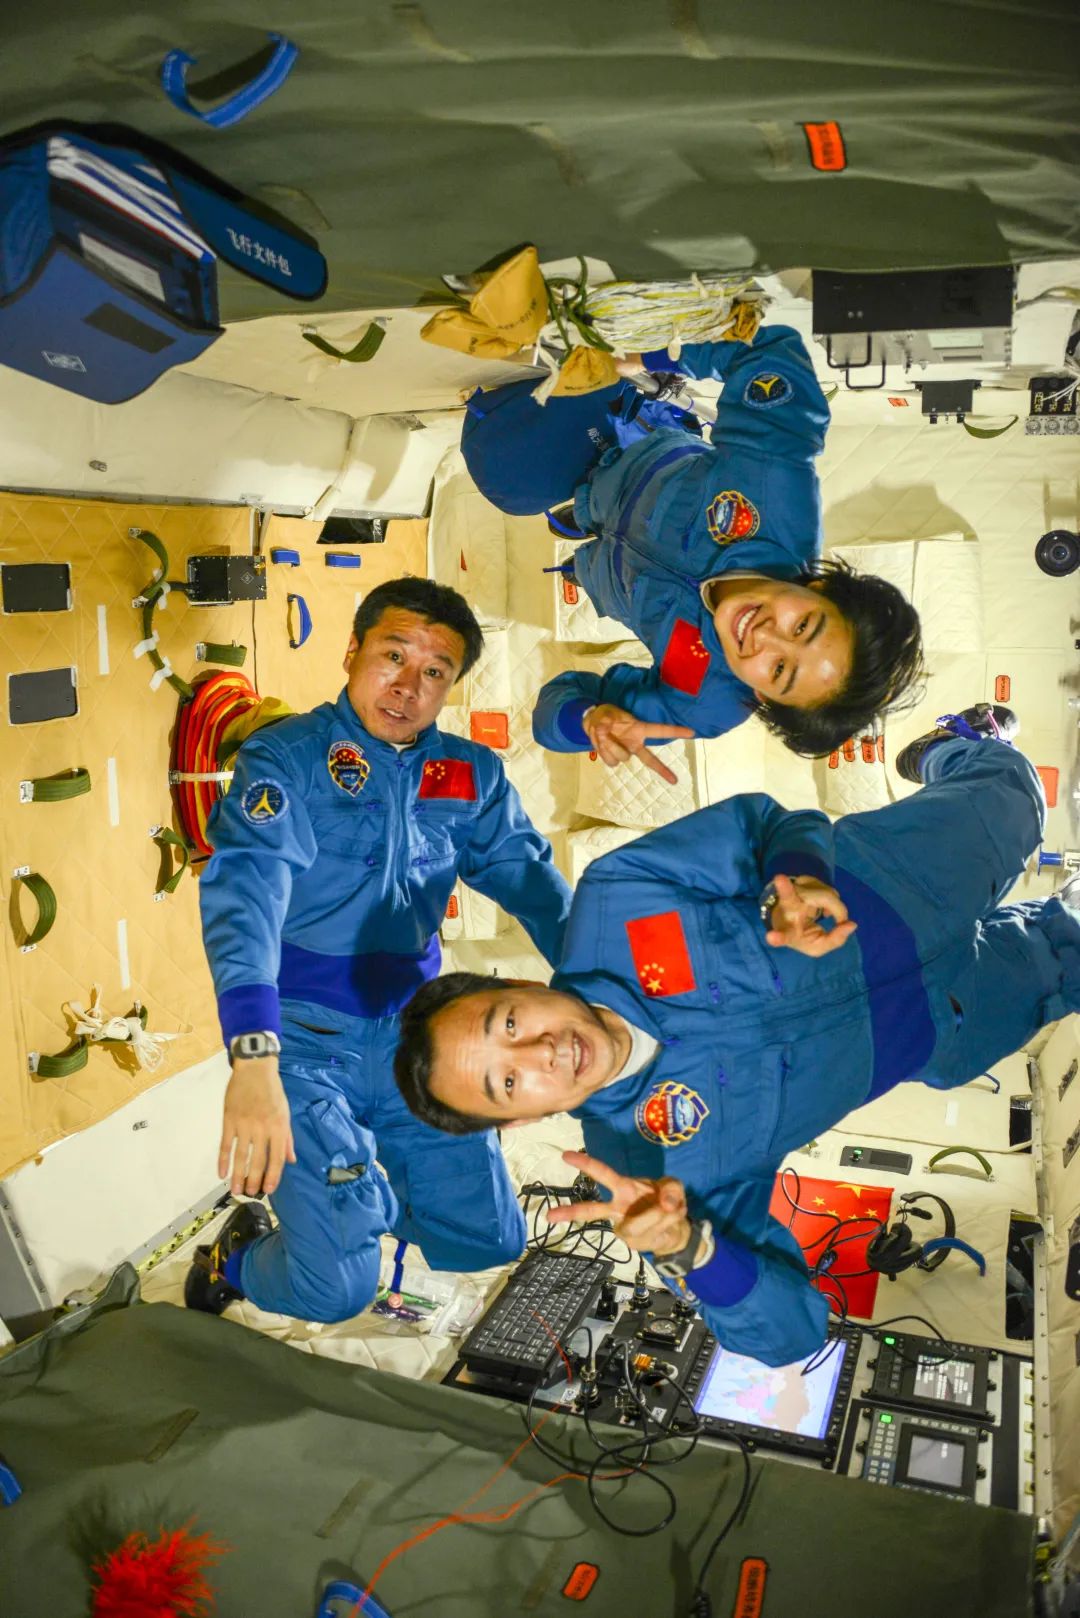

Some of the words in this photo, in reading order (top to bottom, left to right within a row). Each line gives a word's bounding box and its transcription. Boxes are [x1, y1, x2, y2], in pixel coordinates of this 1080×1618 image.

[226, 227, 292, 276] 飞行文件包
